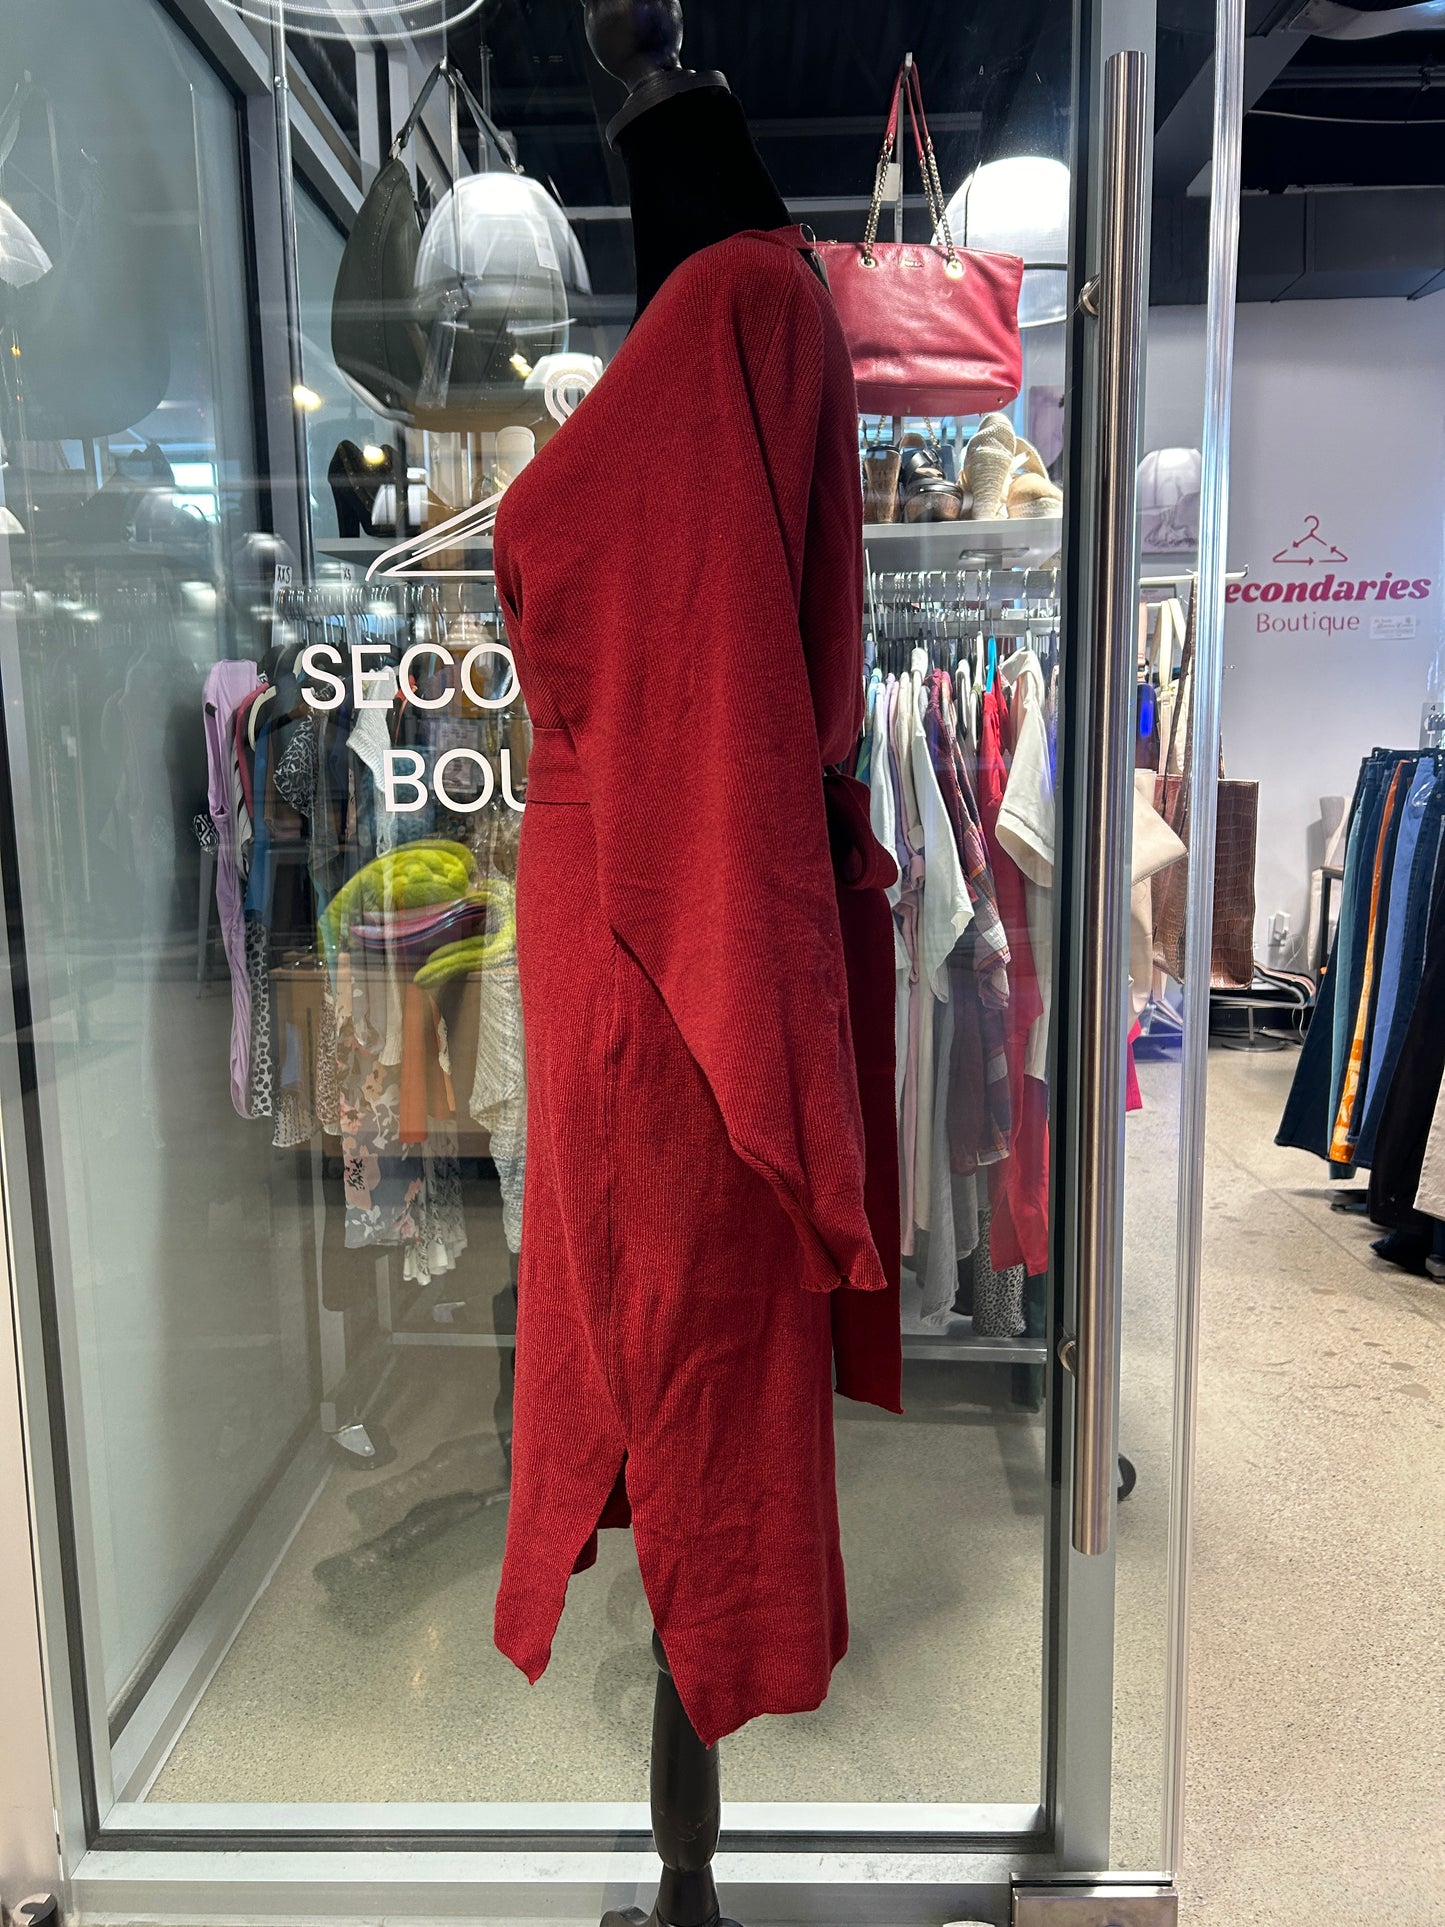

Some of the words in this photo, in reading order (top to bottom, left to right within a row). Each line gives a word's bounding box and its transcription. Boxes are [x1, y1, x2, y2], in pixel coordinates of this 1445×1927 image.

[277, 566, 291, 584] XXS
[342, 568, 352, 581] XS
[1257, 612, 1360, 636] Boutique
[301, 643, 521, 709] SECO
